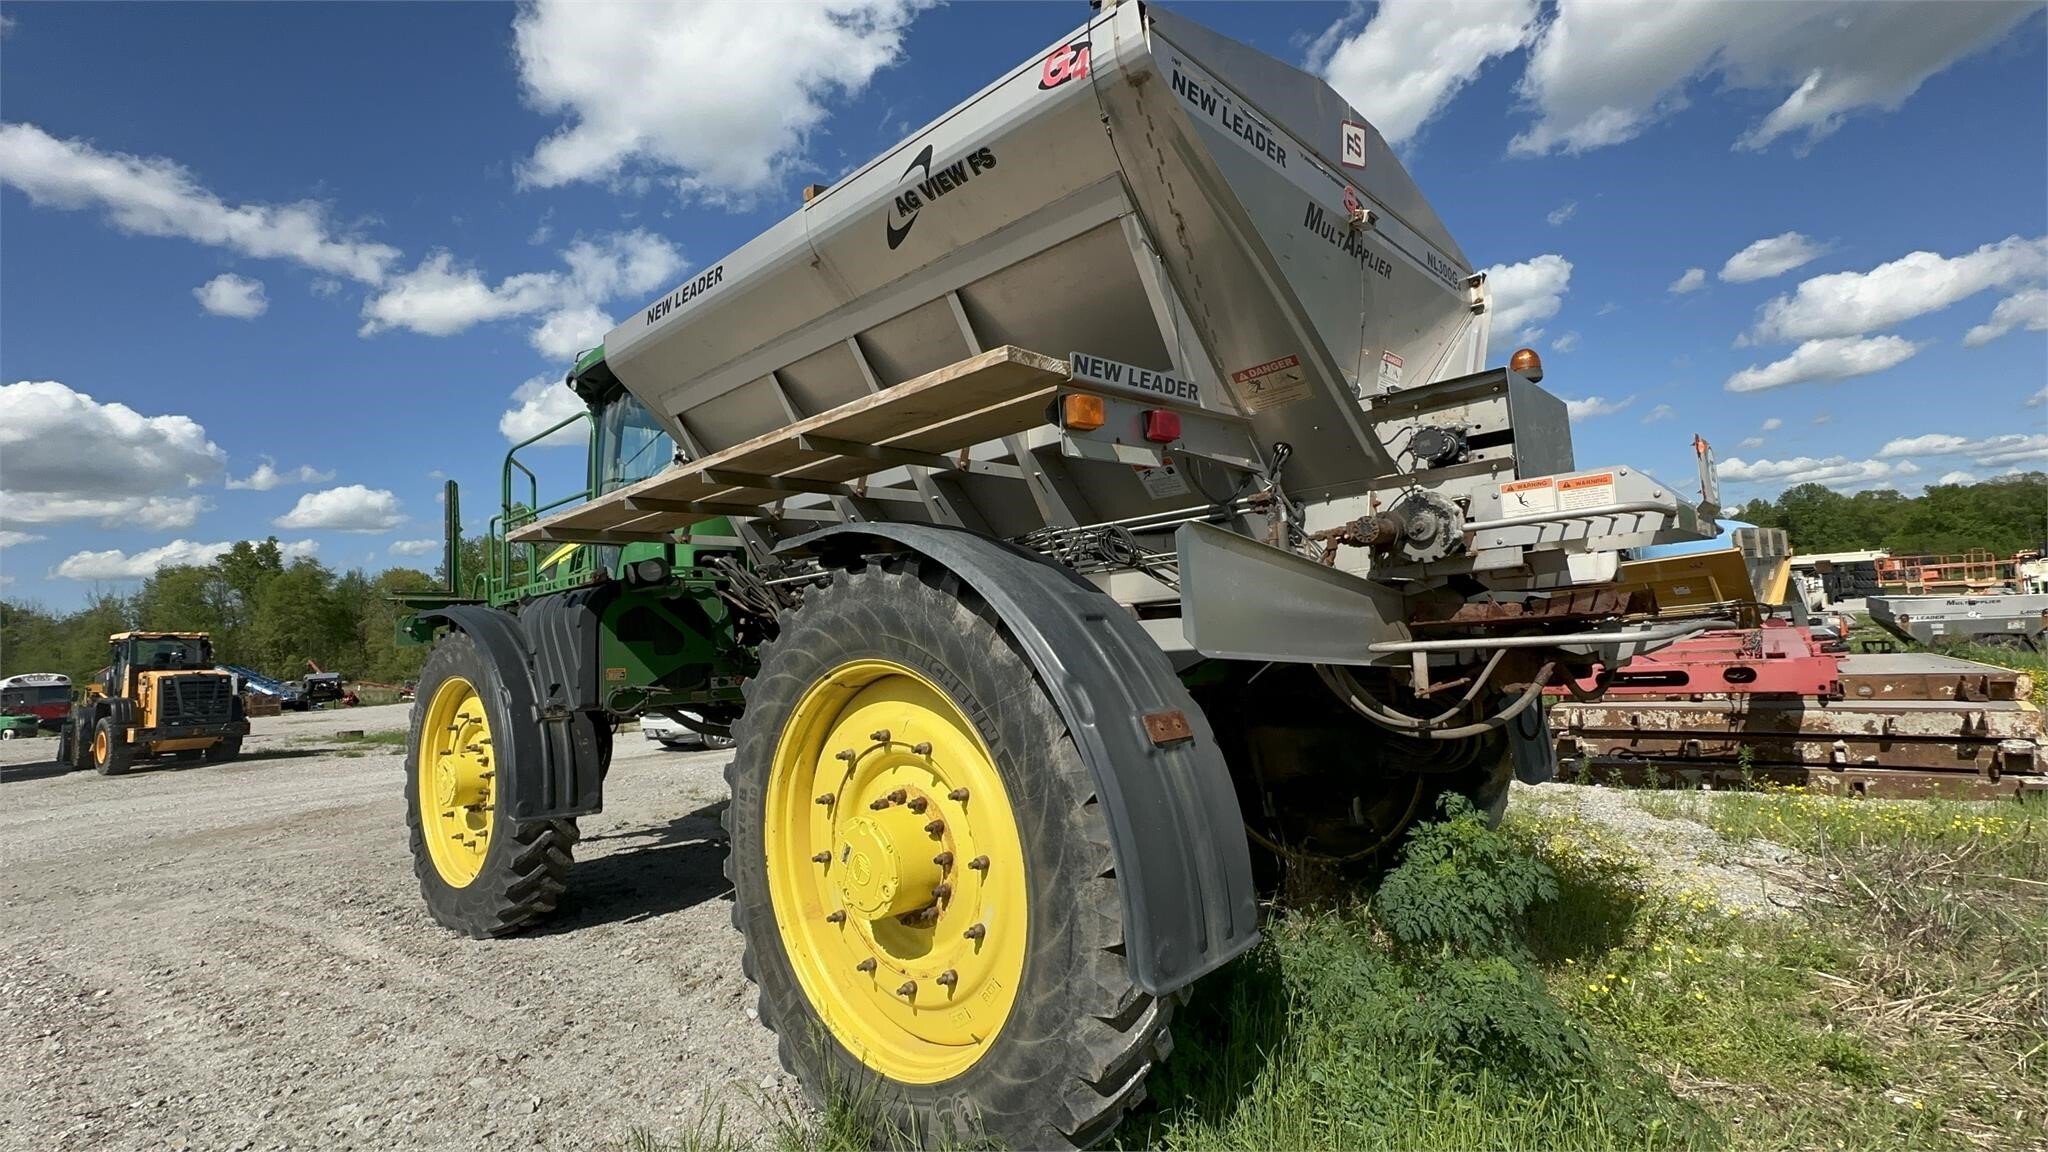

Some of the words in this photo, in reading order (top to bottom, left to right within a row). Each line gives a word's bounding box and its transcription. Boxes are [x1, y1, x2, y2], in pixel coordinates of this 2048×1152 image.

[1171, 69, 1217, 117] NEW
[1221, 105, 1287, 168] LEADER
[1346, 132, 1363, 159] FS
[895, 190, 924, 218] AG
[917, 159, 968, 201] VIEW
[966, 147, 997, 177] FS
[647, 296, 672, 326] NEW
[675, 265, 723, 309] LEADER
[1073, 354, 1122, 383] NEW
[1128, 368, 1199, 401] LEADER
[1248, 358, 1294, 379] DANGER
[1517, 480, 1548, 490] WARNING
[1576, 477, 1608, 487] WARNING
